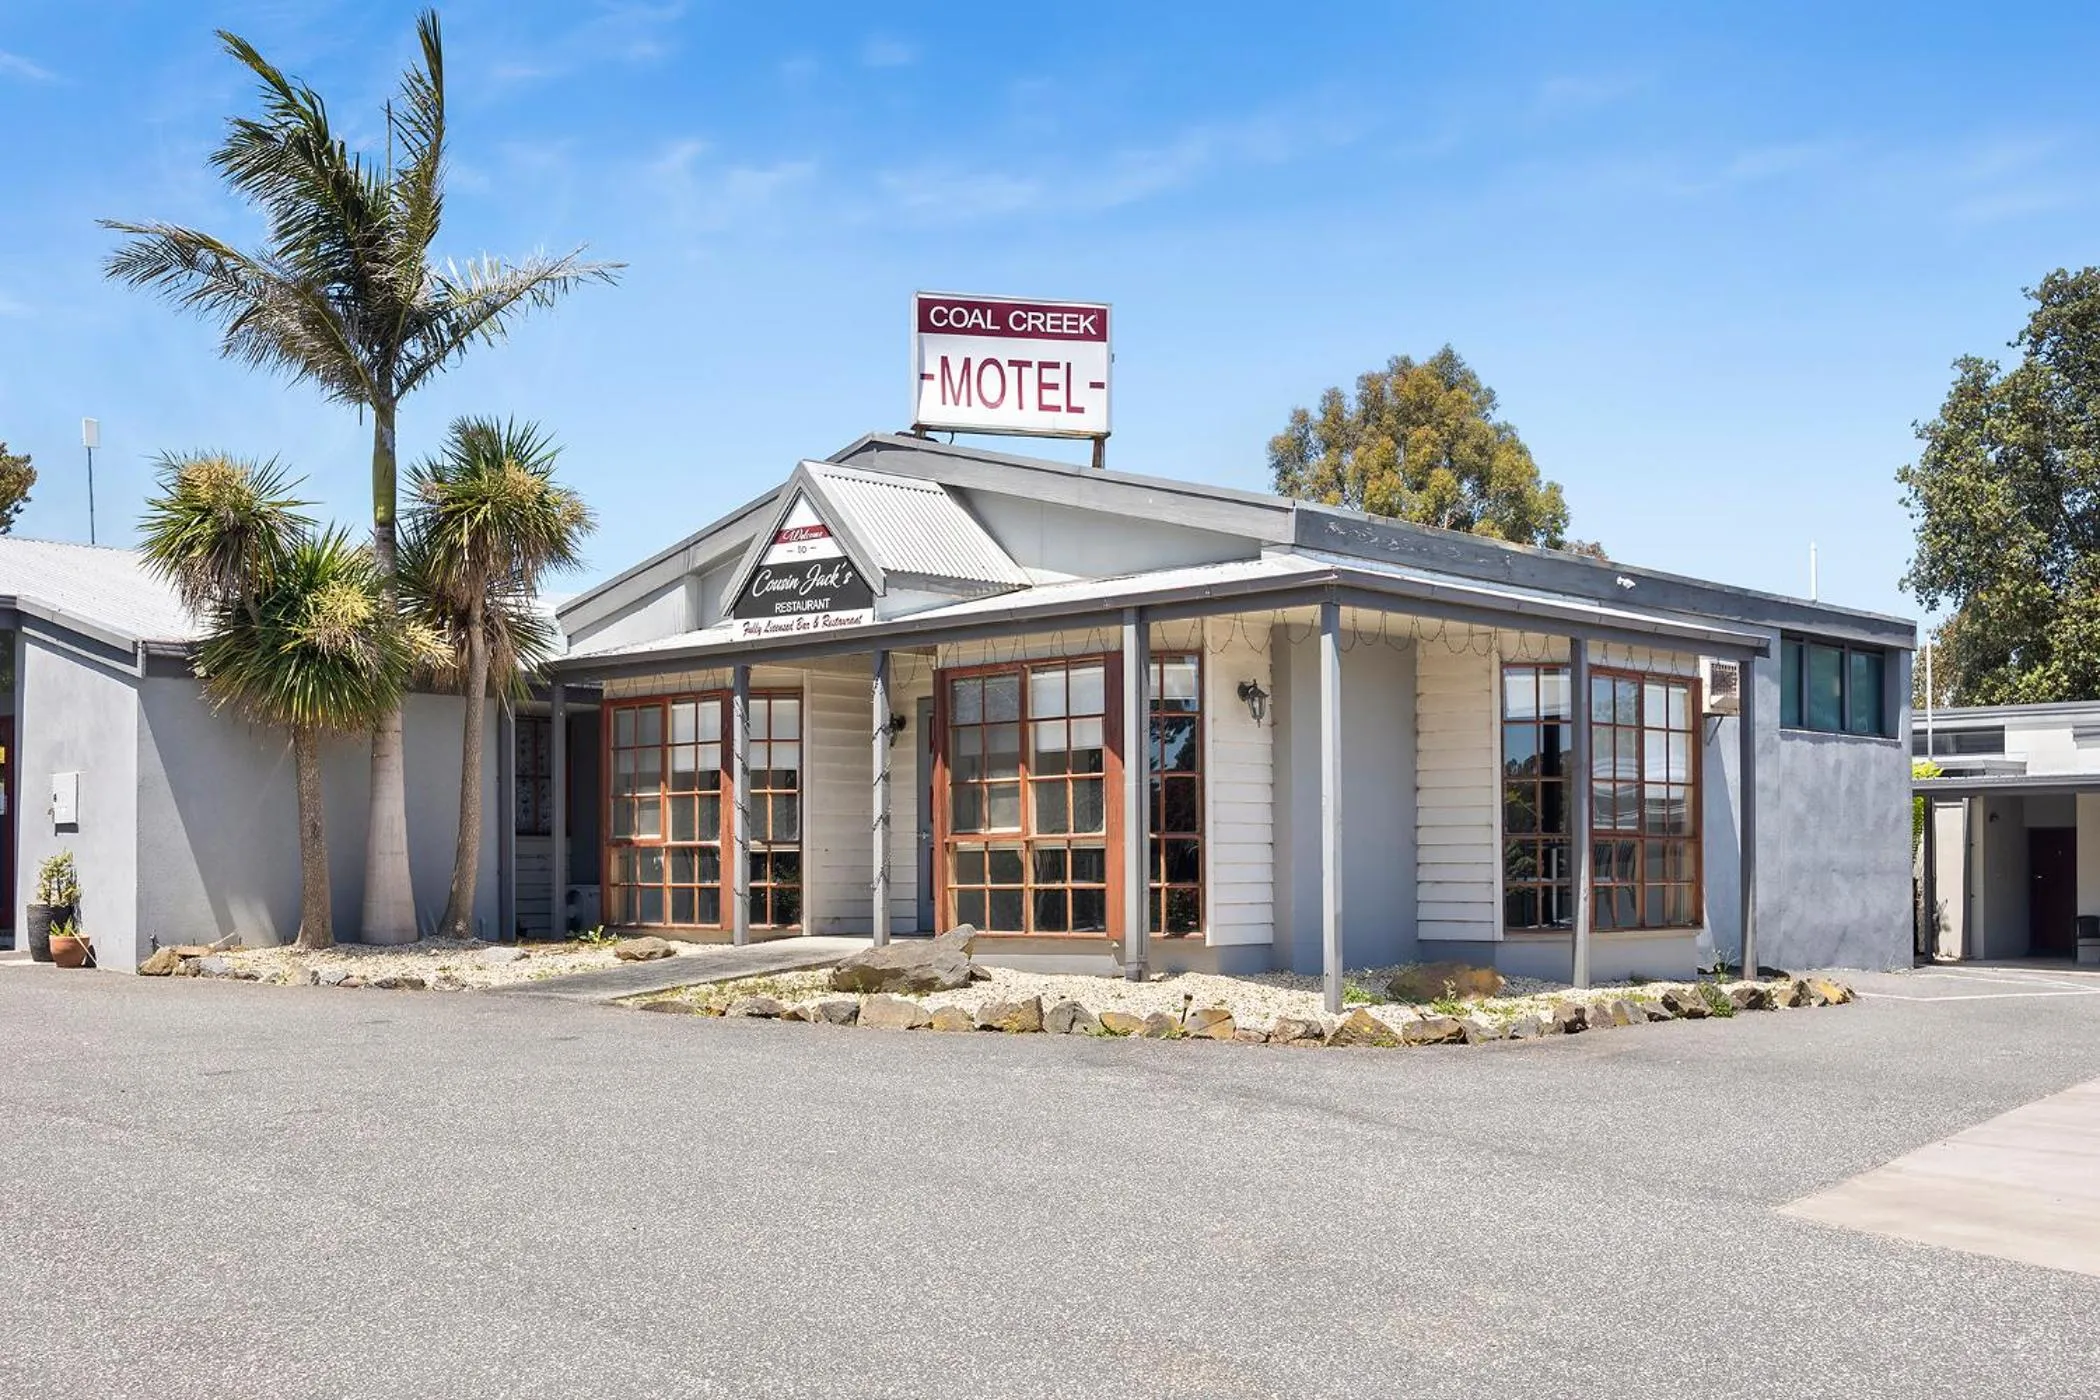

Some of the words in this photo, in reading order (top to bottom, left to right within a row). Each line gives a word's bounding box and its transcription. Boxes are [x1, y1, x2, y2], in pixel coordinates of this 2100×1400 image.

[930, 306, 1000, 330] COAL
[1008, 310, 1097, 335] CREEK
[752, 569, 799, 597] Cousin
[799, 562, 852, 595] Jack's
[775, 598, 830, 613] RESTAURANT
[743, 621, 762, 637] Fully
[796, 616, 810, 631] Bar
[822, 614, 863, 627] Restaurant
